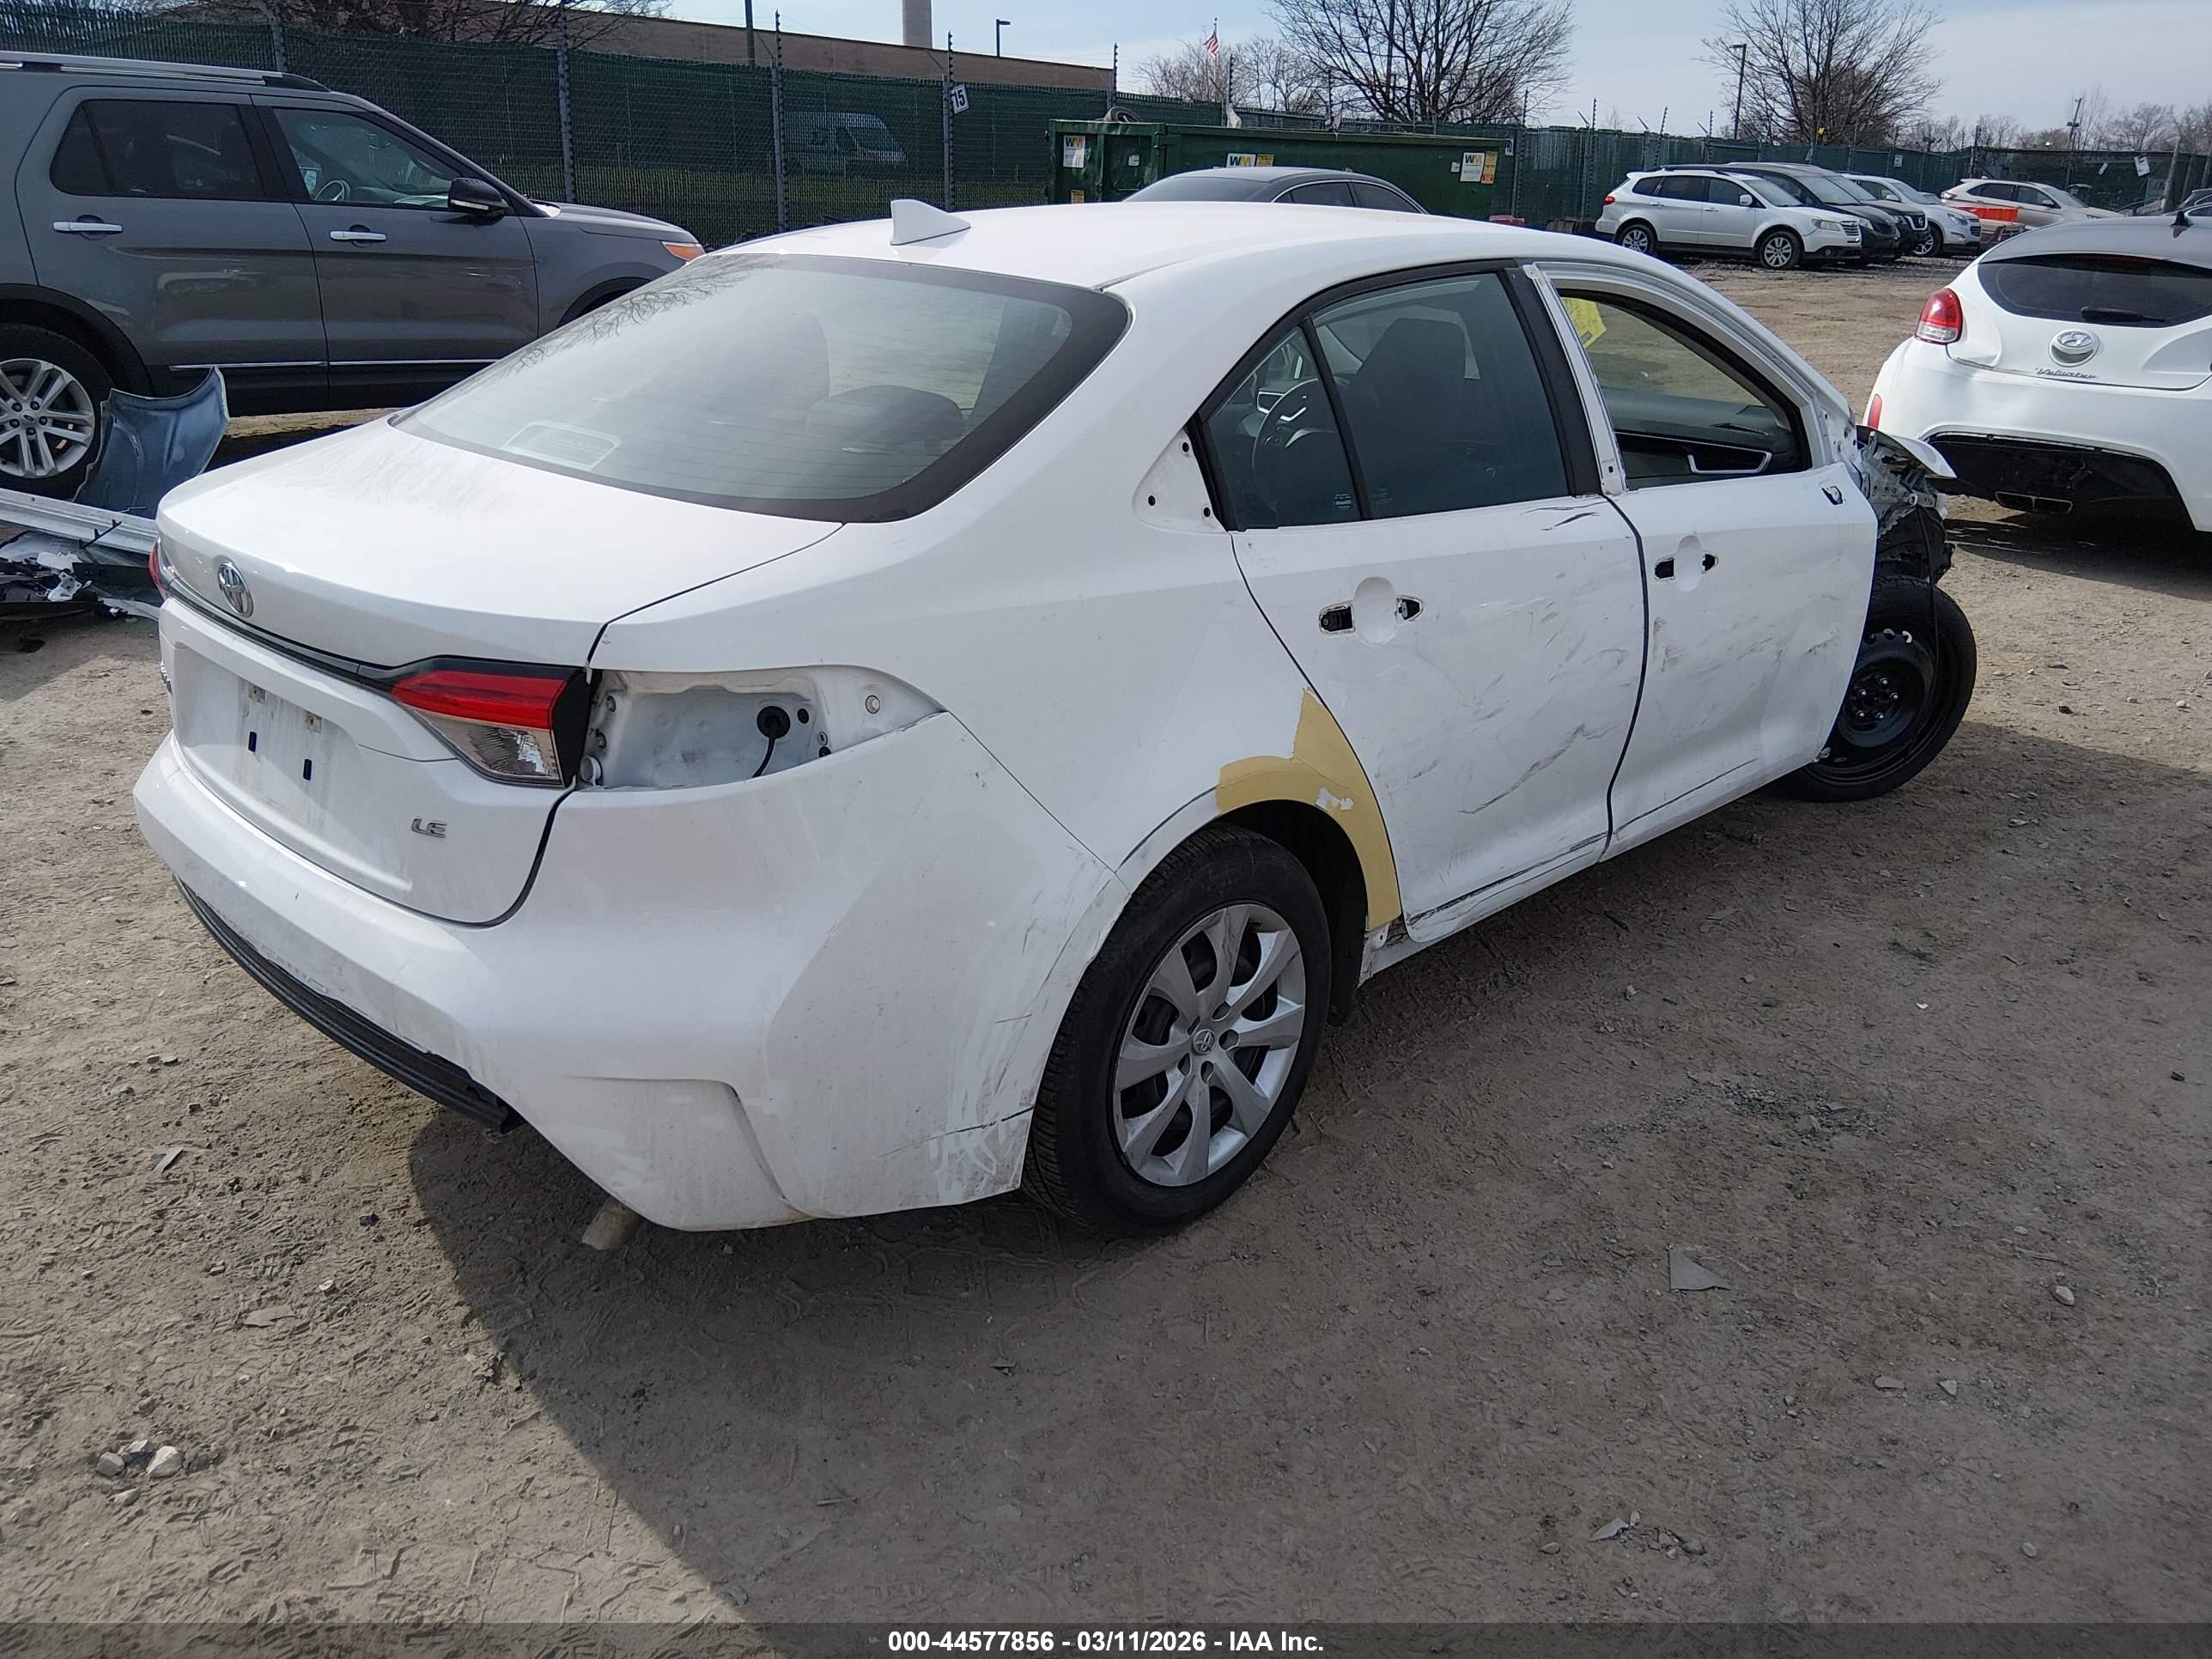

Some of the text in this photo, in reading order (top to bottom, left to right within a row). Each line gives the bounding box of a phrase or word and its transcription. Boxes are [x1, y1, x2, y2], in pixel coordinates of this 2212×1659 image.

[952, 88, 966, 108] 15
[1230, 155, 1251, 166] WM
[411, 817, 447, 839] LE
